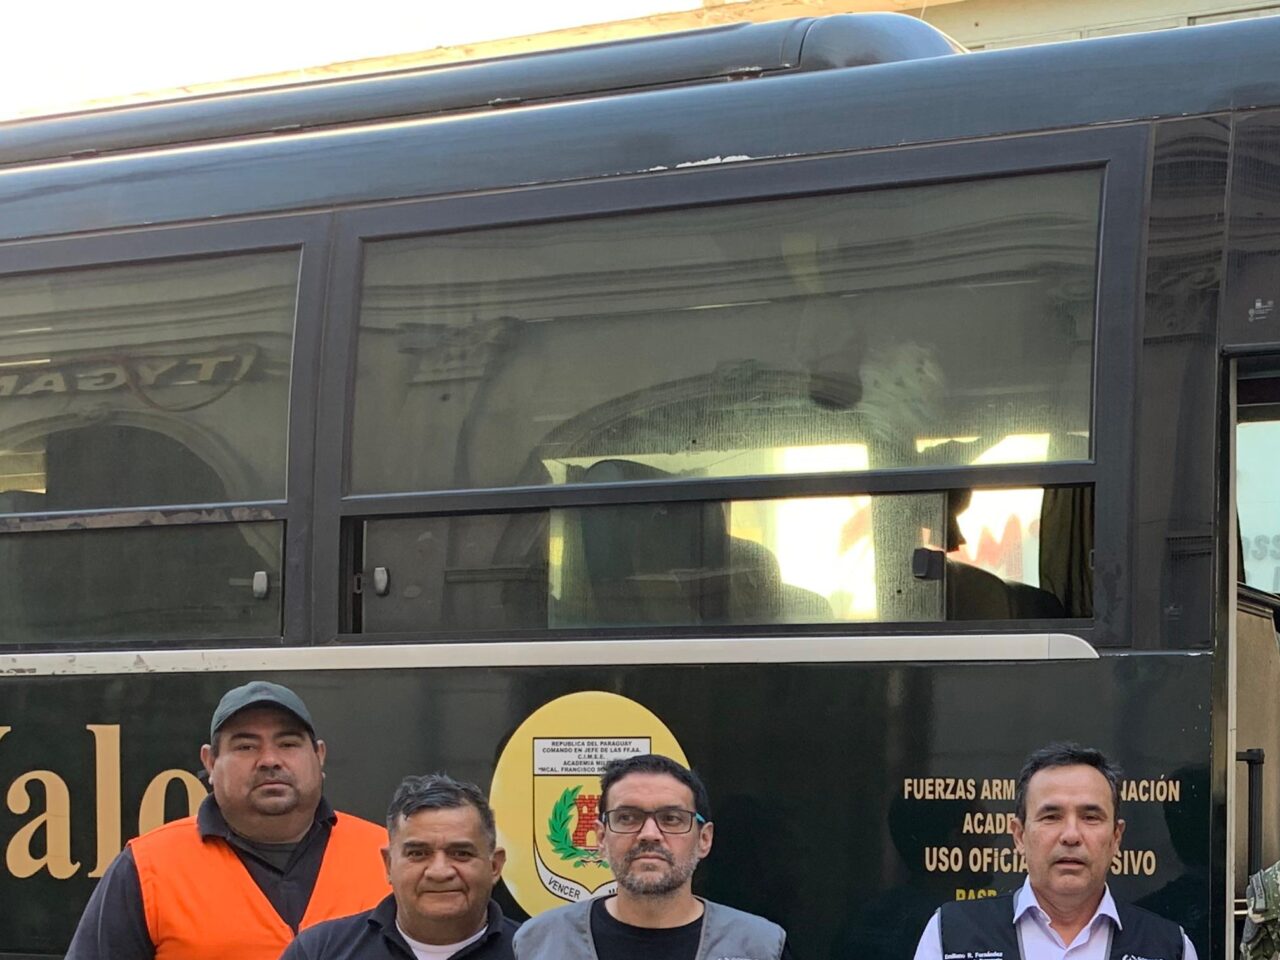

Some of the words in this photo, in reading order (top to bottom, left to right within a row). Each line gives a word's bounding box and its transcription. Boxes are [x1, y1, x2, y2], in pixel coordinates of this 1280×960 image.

[904, 778, 976, 801] FUERZAS
[980, 778, 1016, 801] ARM
[962, 812, 1016, 834] ACADE
[924, 847, 963, 873] USO
[969, 847, 1029, 873] OFICIA
[1110, 850, 1156, 875] SIVO
[548, 877, 581, 899] VENCER
